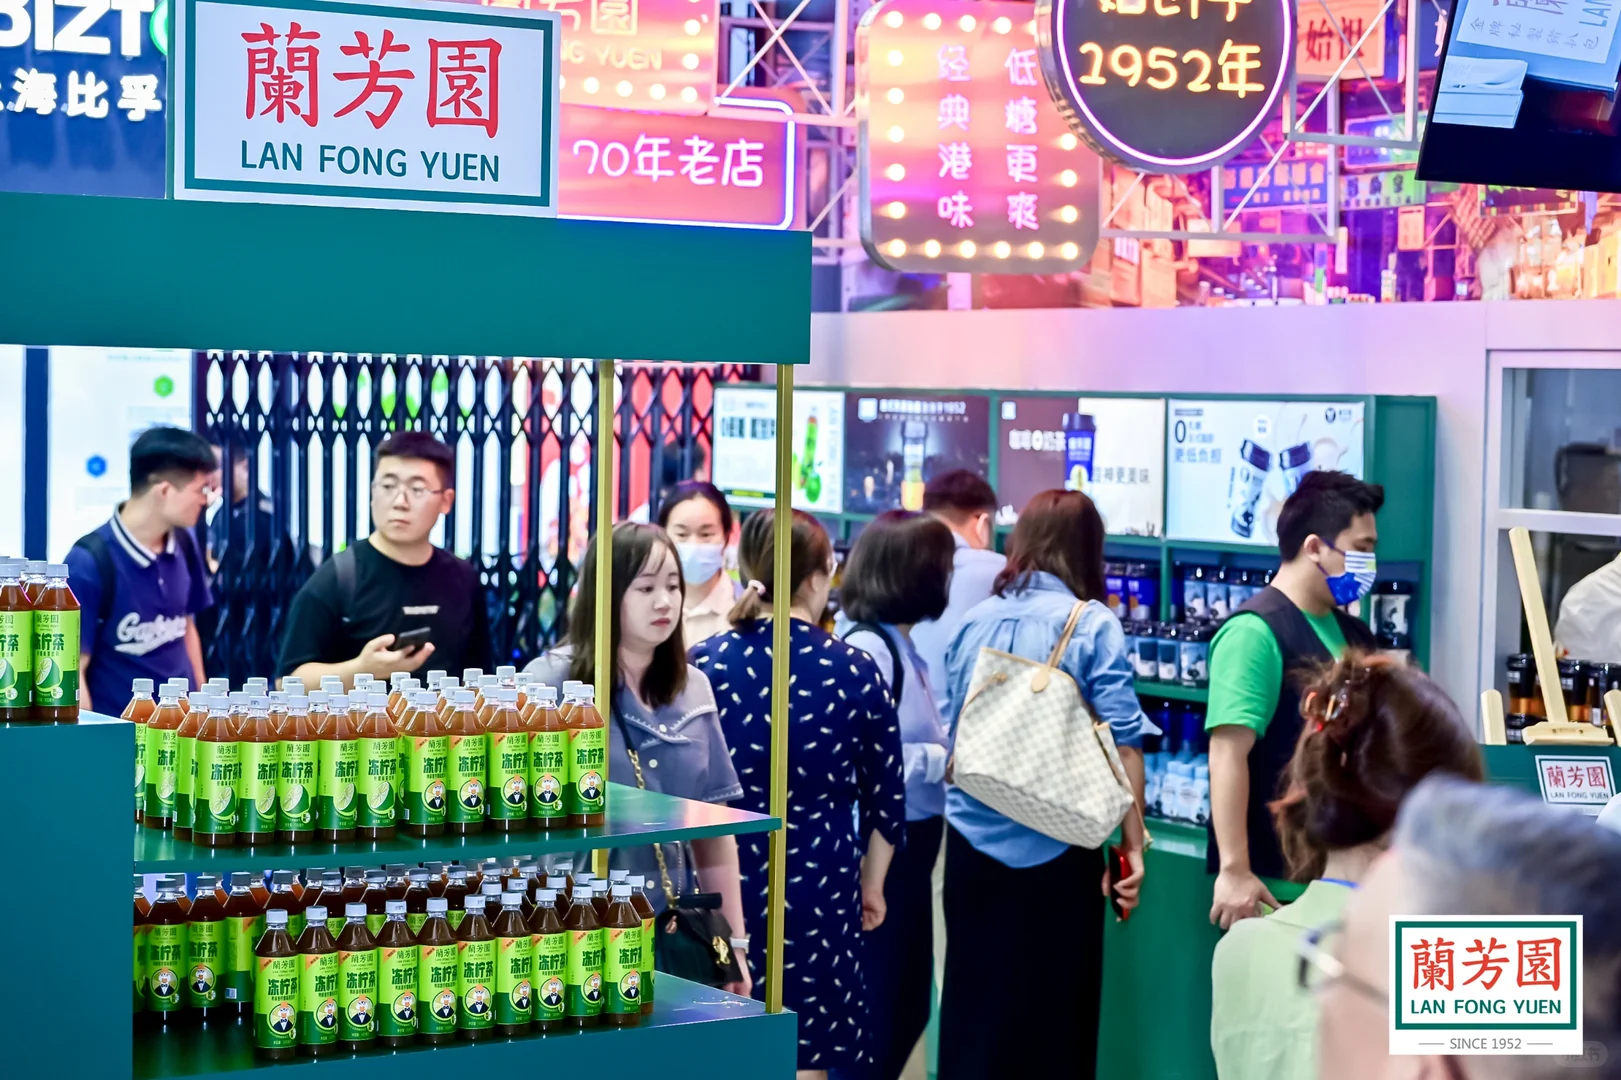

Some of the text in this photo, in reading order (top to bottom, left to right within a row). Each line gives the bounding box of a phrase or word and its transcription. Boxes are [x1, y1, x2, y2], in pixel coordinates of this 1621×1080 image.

[597, 45, 662, 70] YUEN
[1079, 39, 1265, 98] 1952年
[241, 22, 502, 138] 蘭芳園
[0, 68, 162, 121] 海比孚
[938, 45, 974, 228] 经典港味
[1004, 47, 1040, 230] 低糖更爽
[241, 140, 499, 183] LAN FONG YUEN
[573, 134, 764, 188] 70年老店
[458, 755, 485, 773] 冻柠茶
[533, 752, 564, 768] 冻柠茶
[577, 748, 605, 765] 冻柠茶
[281, 762, 314, 779] 冻柠茶
[368, 759, 397, 777] 冻柠茶
[1546, 765, 1606, 789] 蘭芳園
[463, 961, 494, 978] 冻柠茶
[538, 952, 567, 971] 冻柠茶
[268, 977, 298, 996] 冻柠茶
[346, 970, 376, 989] 冻柠茶
